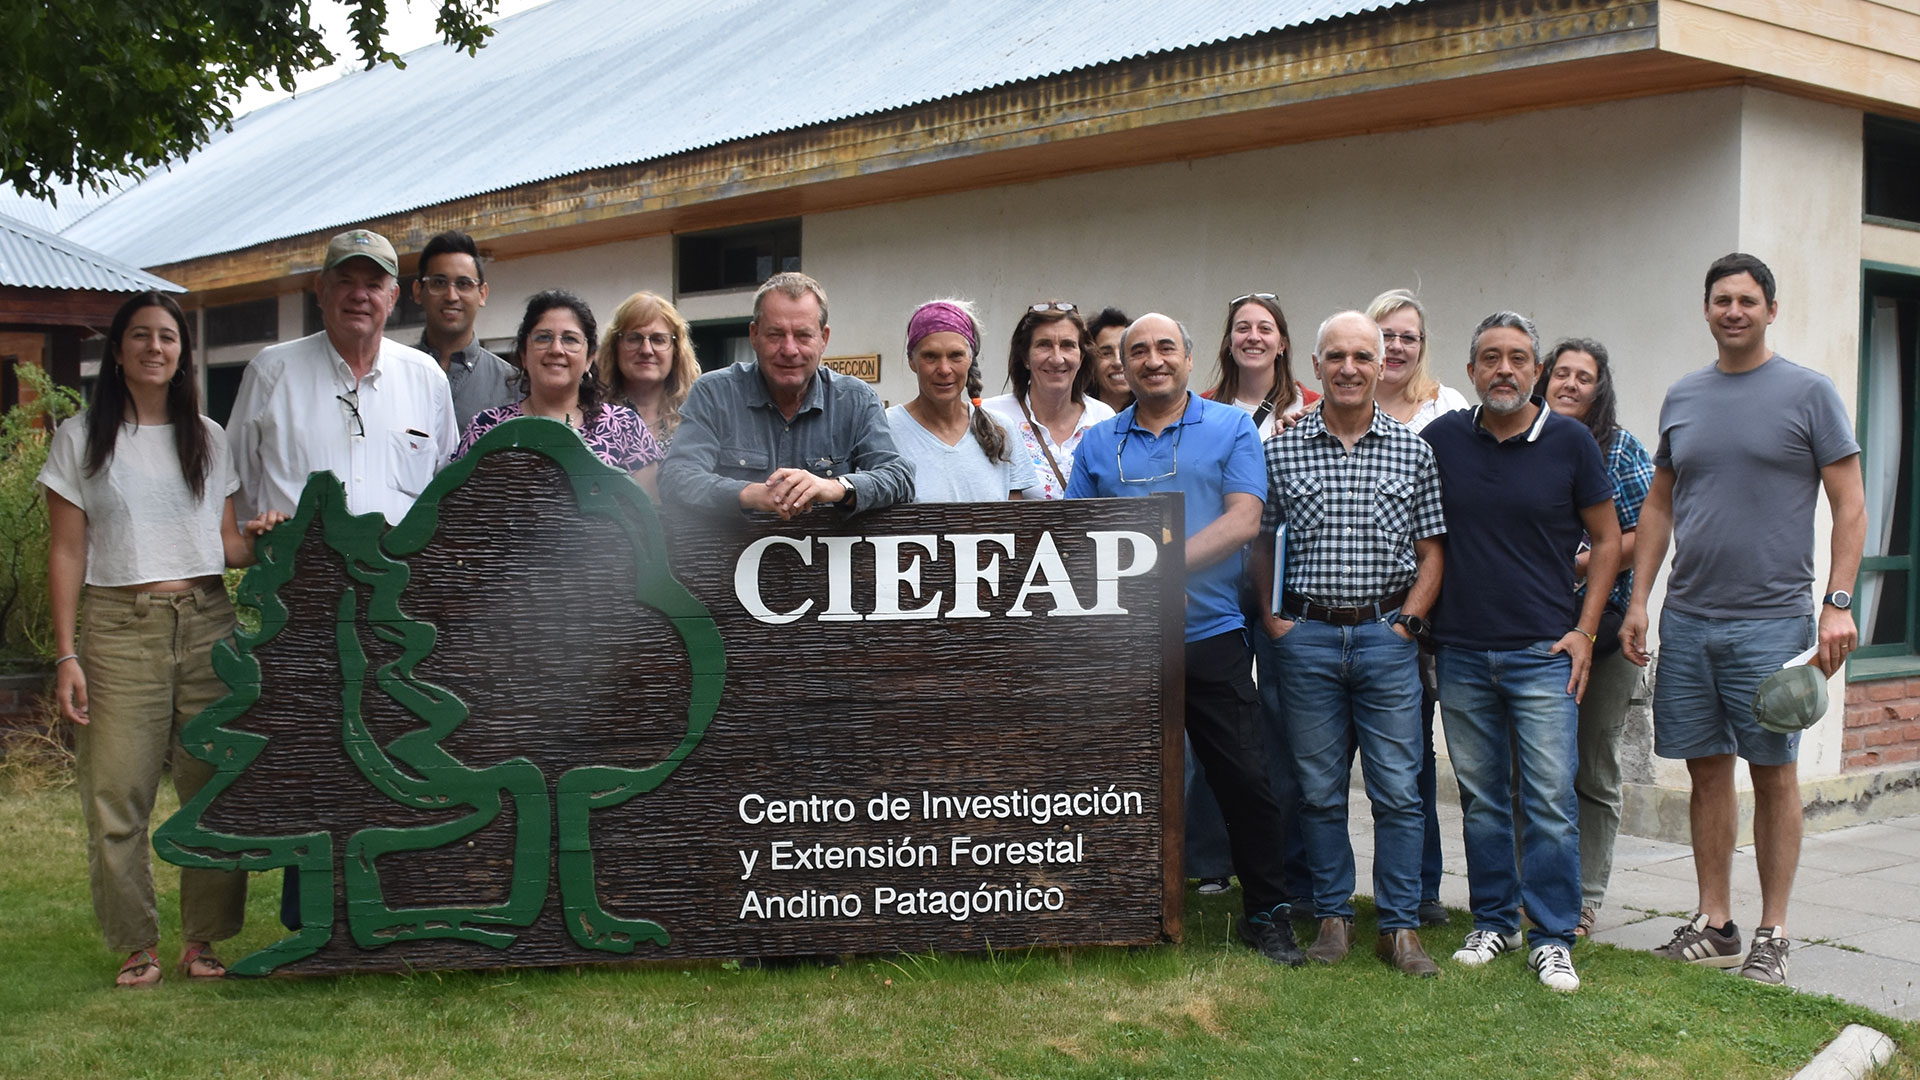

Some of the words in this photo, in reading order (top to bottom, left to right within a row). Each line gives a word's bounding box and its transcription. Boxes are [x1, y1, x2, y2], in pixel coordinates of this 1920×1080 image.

[734, 530, 1159, 625] CIEFAP
[738, 793, 856, 825] Centro
[867, 791, 911, 821] de
[922, 784, 1143, 825] Investigación
[738, 849, 759, 881] y
[770, 836, 938, 871] Extensión
[950, 833, 1085, 866] Forestal
[738, 889, 862, 920] Andino
[874, 881, 1064, 921] Patagónico
